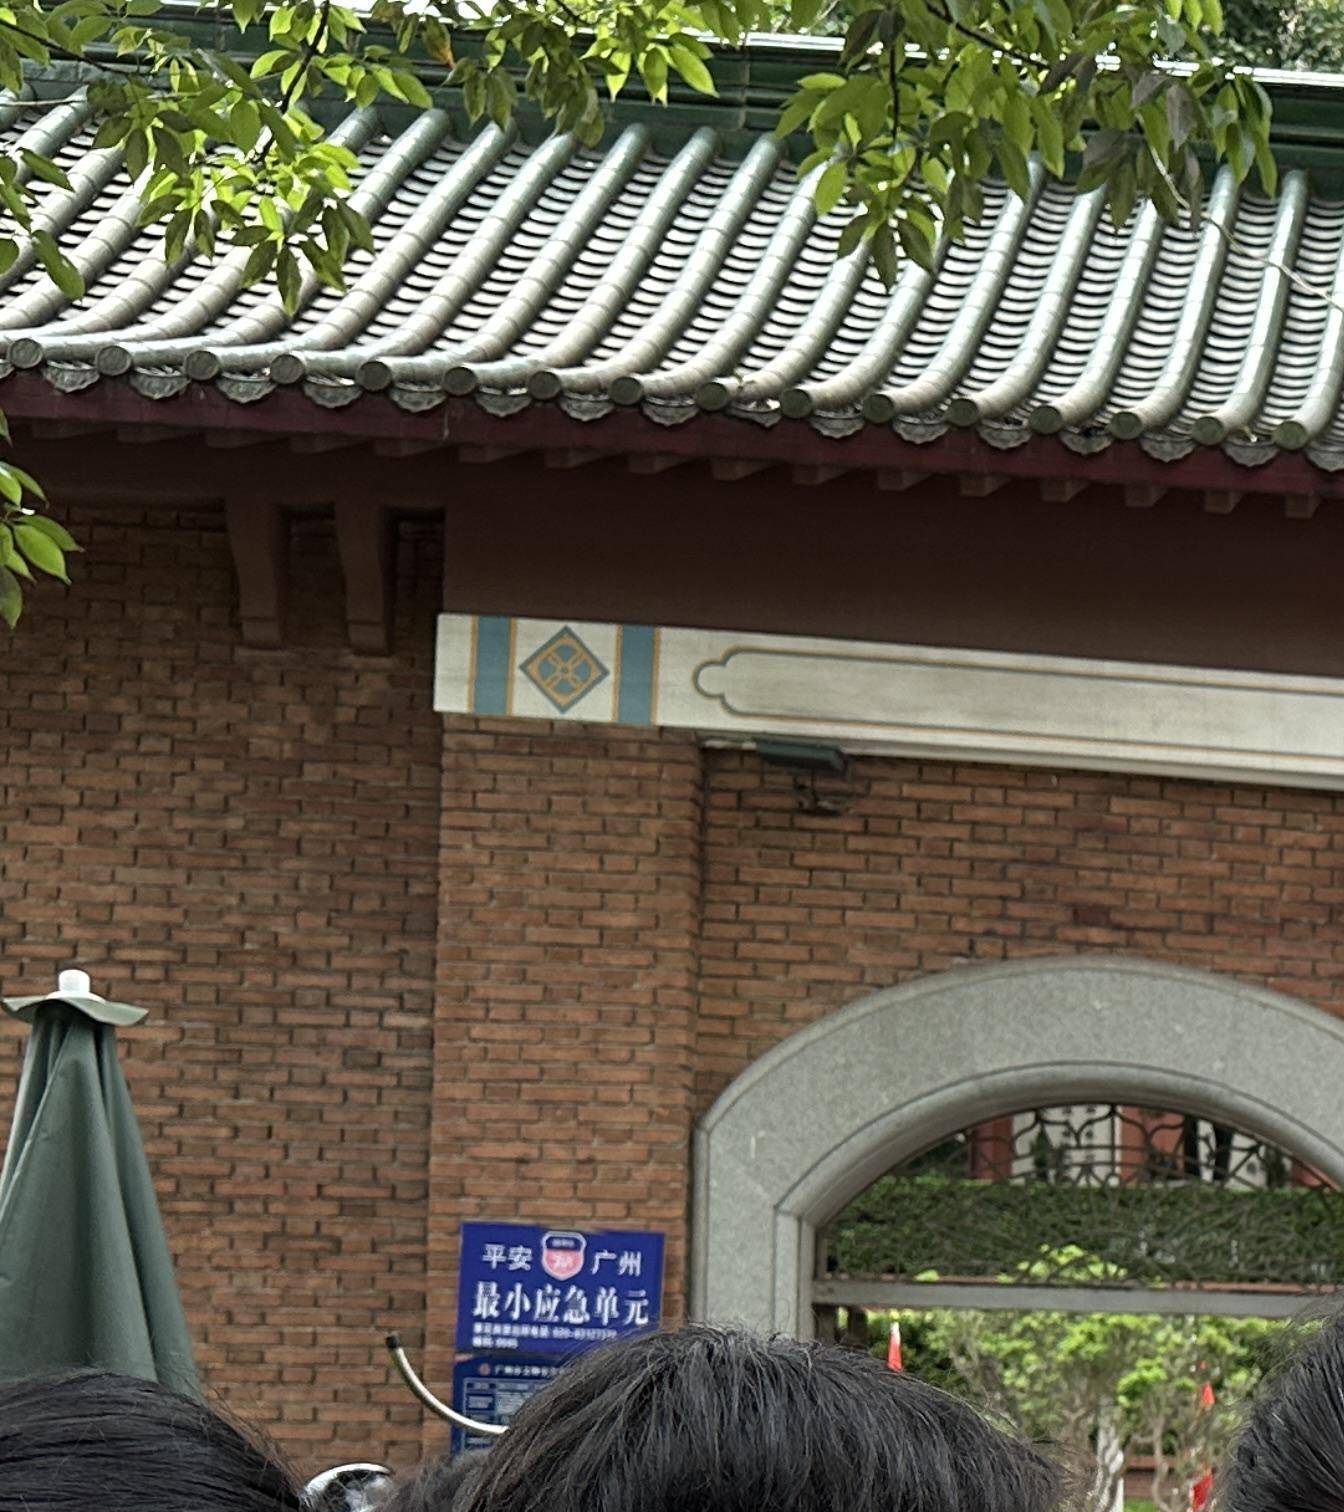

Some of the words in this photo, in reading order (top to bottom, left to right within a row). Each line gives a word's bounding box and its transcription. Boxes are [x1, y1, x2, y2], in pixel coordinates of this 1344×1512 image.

[481, 1243, 533, 1272] 平安
[591, 1249, 642, 1277] 广州
[473, 1280, 650, 1326] 最小应急单元
